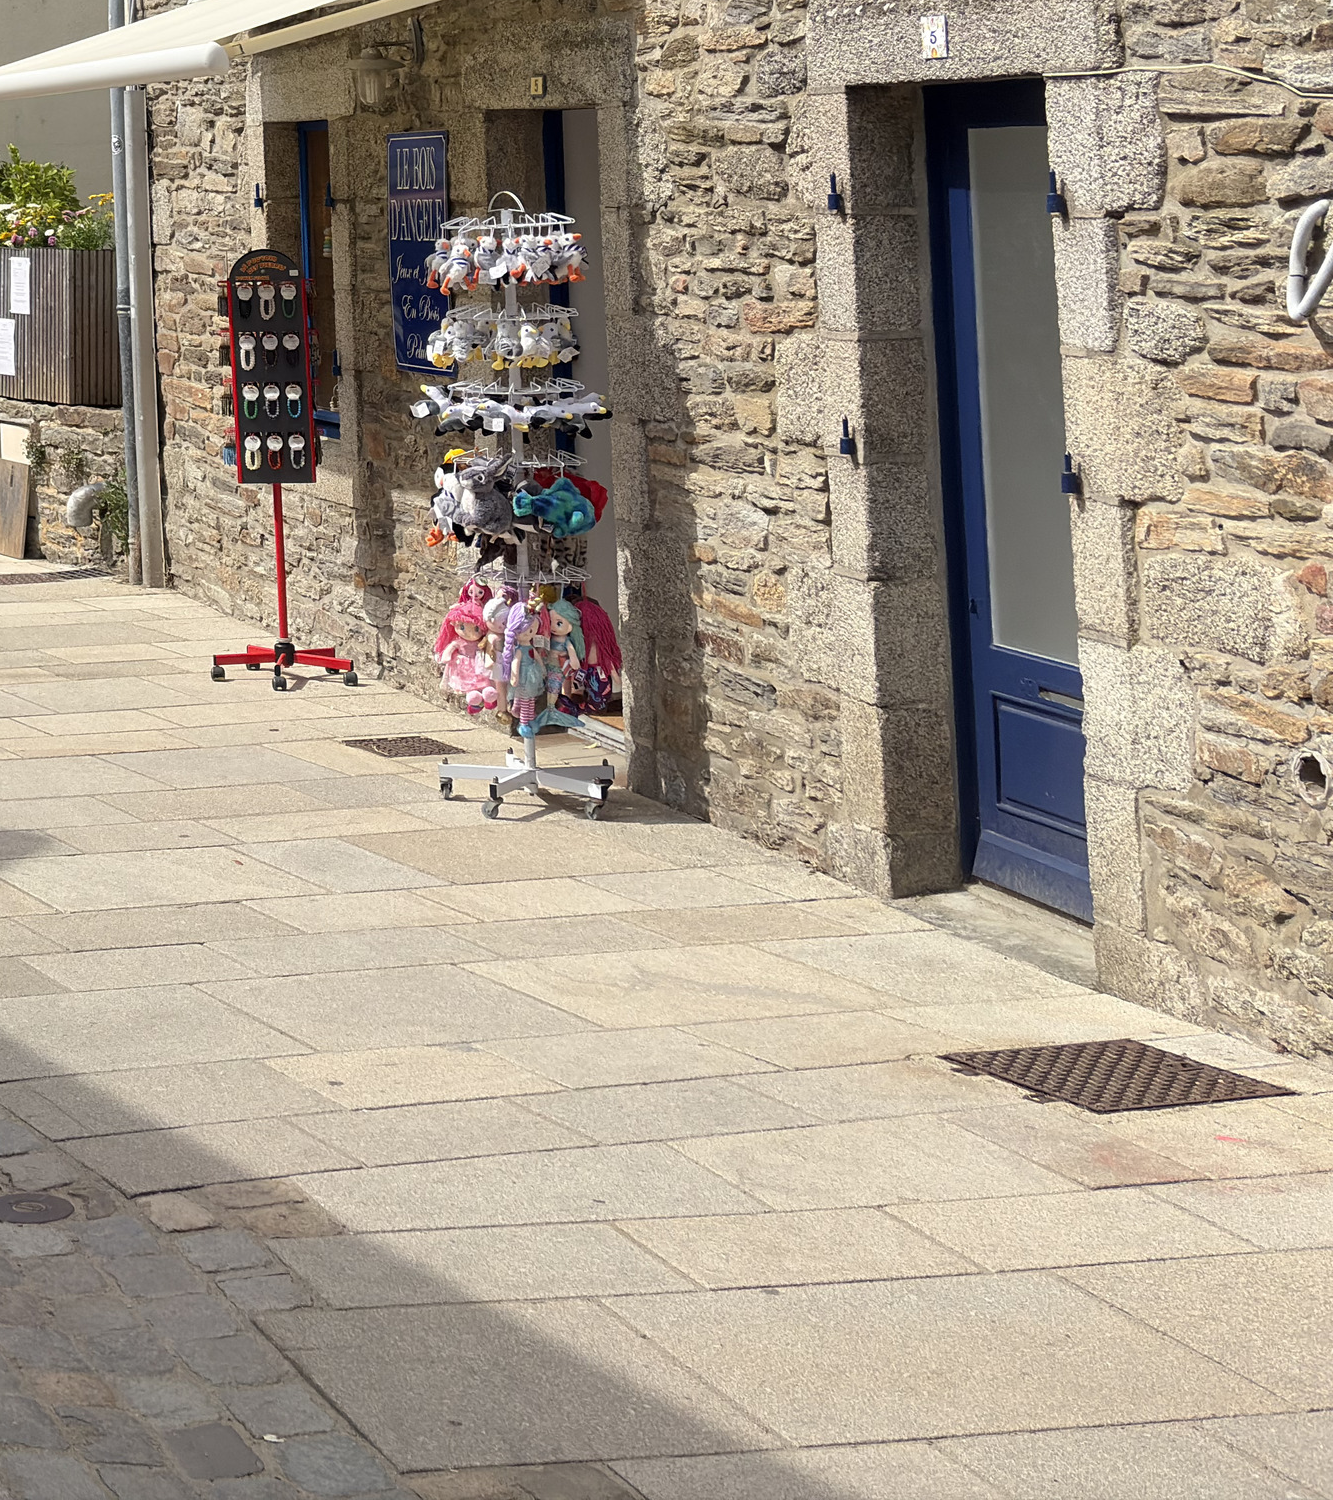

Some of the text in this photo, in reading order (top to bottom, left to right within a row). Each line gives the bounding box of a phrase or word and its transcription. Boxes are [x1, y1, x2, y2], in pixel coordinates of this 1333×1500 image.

[930, 30, 937, 45] 5
[396, 146, 436, 190] LE BOIS
[393, 253, 412, 284] Jeux
[413, 265, 420, 280] et
[402, 295, 440, 321] En Bois
